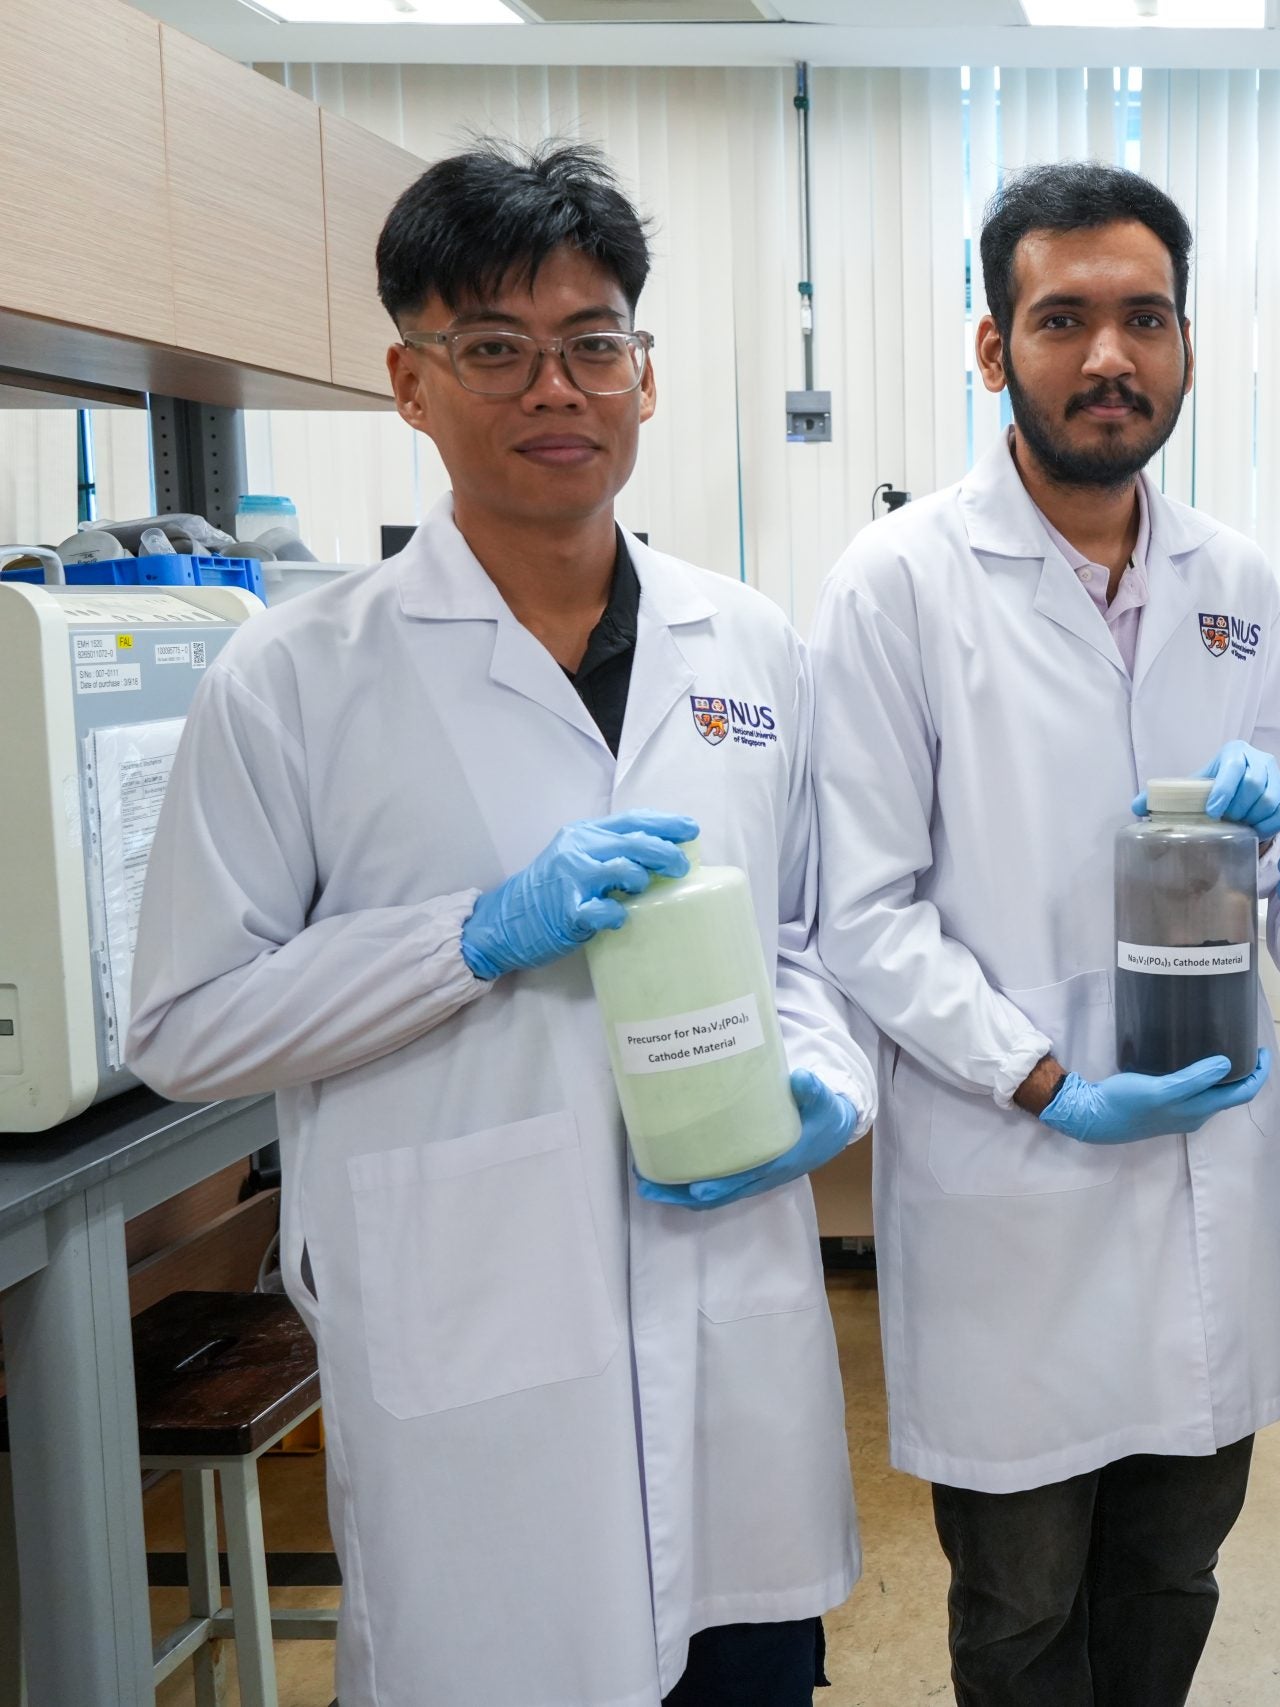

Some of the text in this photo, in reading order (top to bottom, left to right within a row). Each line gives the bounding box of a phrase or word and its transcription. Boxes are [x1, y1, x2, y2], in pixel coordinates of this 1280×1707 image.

[1231, 616, 1261, 647] NUS
[119, 636, 132, 647] FAL
[80, 681, 92, 689] Date
[98, 680, 120, 689] purchase
[728, 699, 775, 730] NUS
[732, 726, 777, 742] National University
[741, 737, 766, 748] Singapore
[1173, 958, 1210, 967] Cathode
[1212, 955, 1243, 966] Material
[627, 1032, 672, 1045] Precursor
[674, 1028, 690, 1040] for
[648, 1036, 736, 1063] Cathode Material
